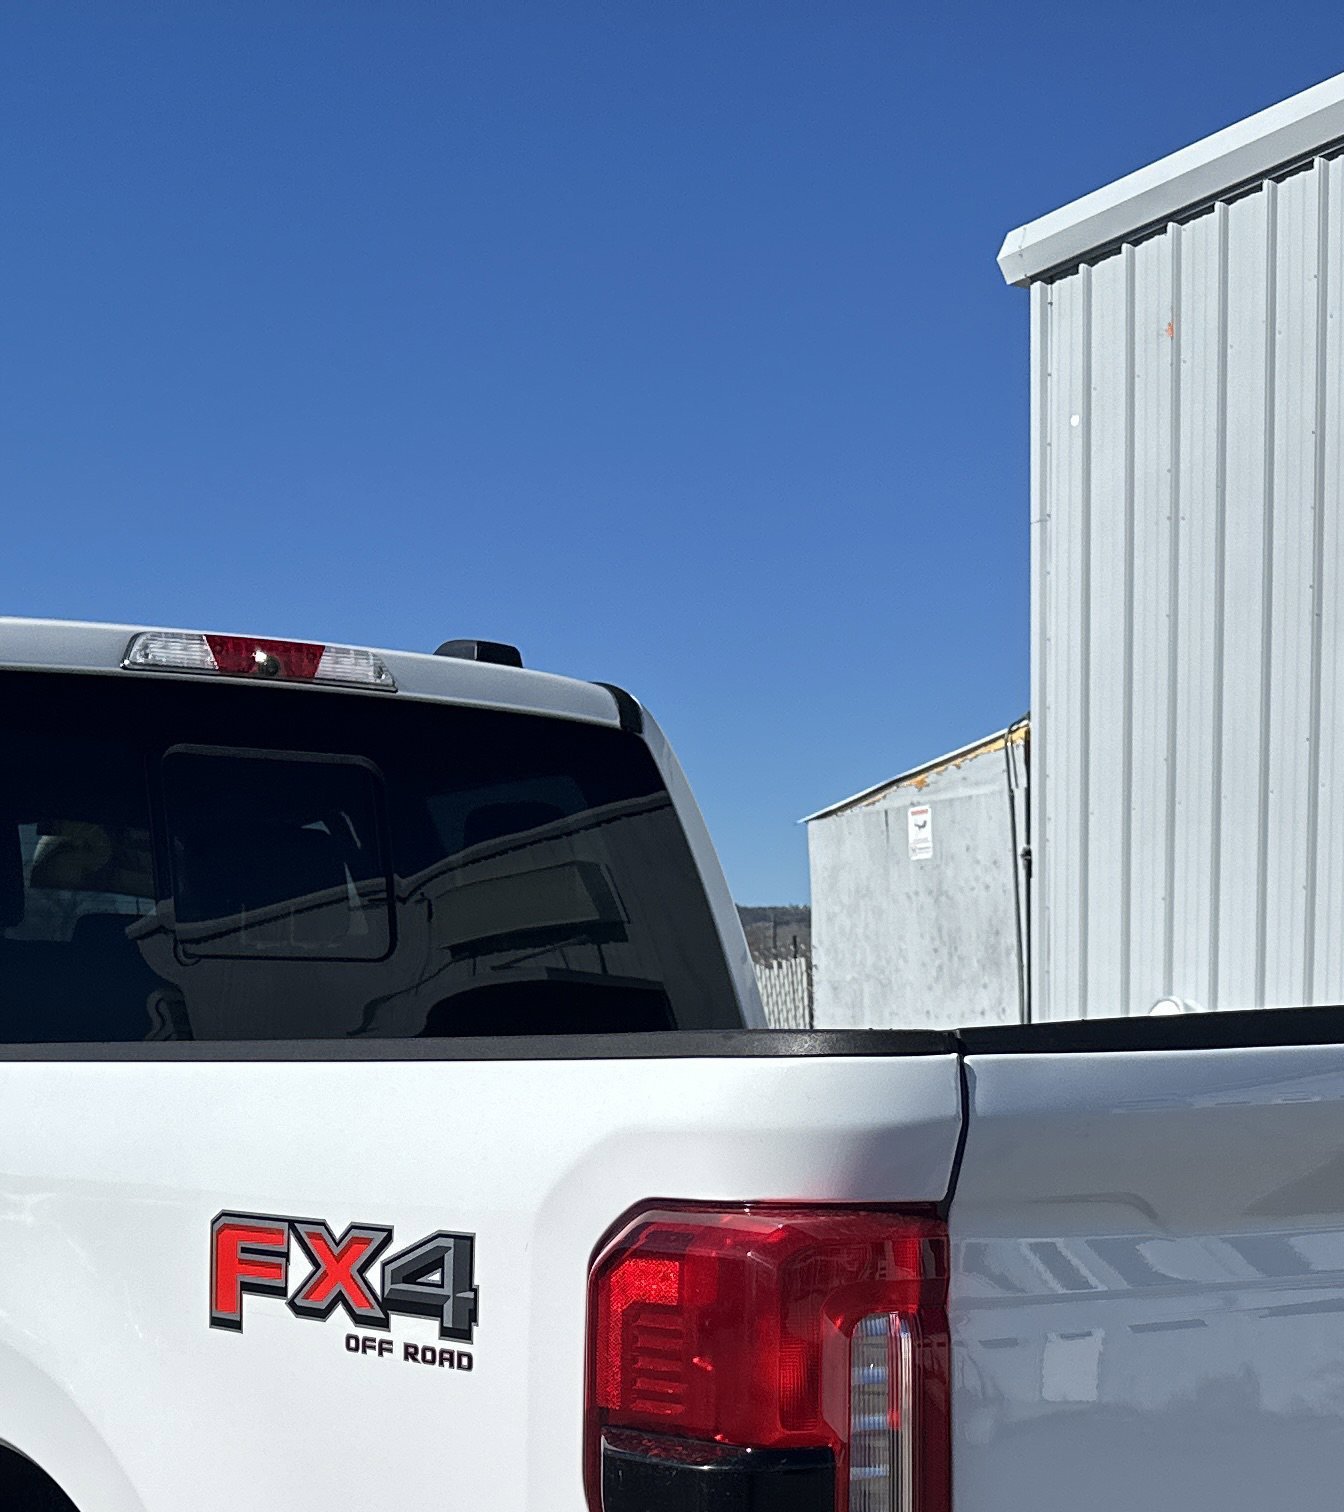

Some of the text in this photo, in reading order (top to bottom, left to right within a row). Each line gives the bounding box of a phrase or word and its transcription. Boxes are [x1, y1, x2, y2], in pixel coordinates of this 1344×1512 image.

[208, 1209, 479, 1345] FX4
[345, 1333, 474, 1372] OFF ROAD
